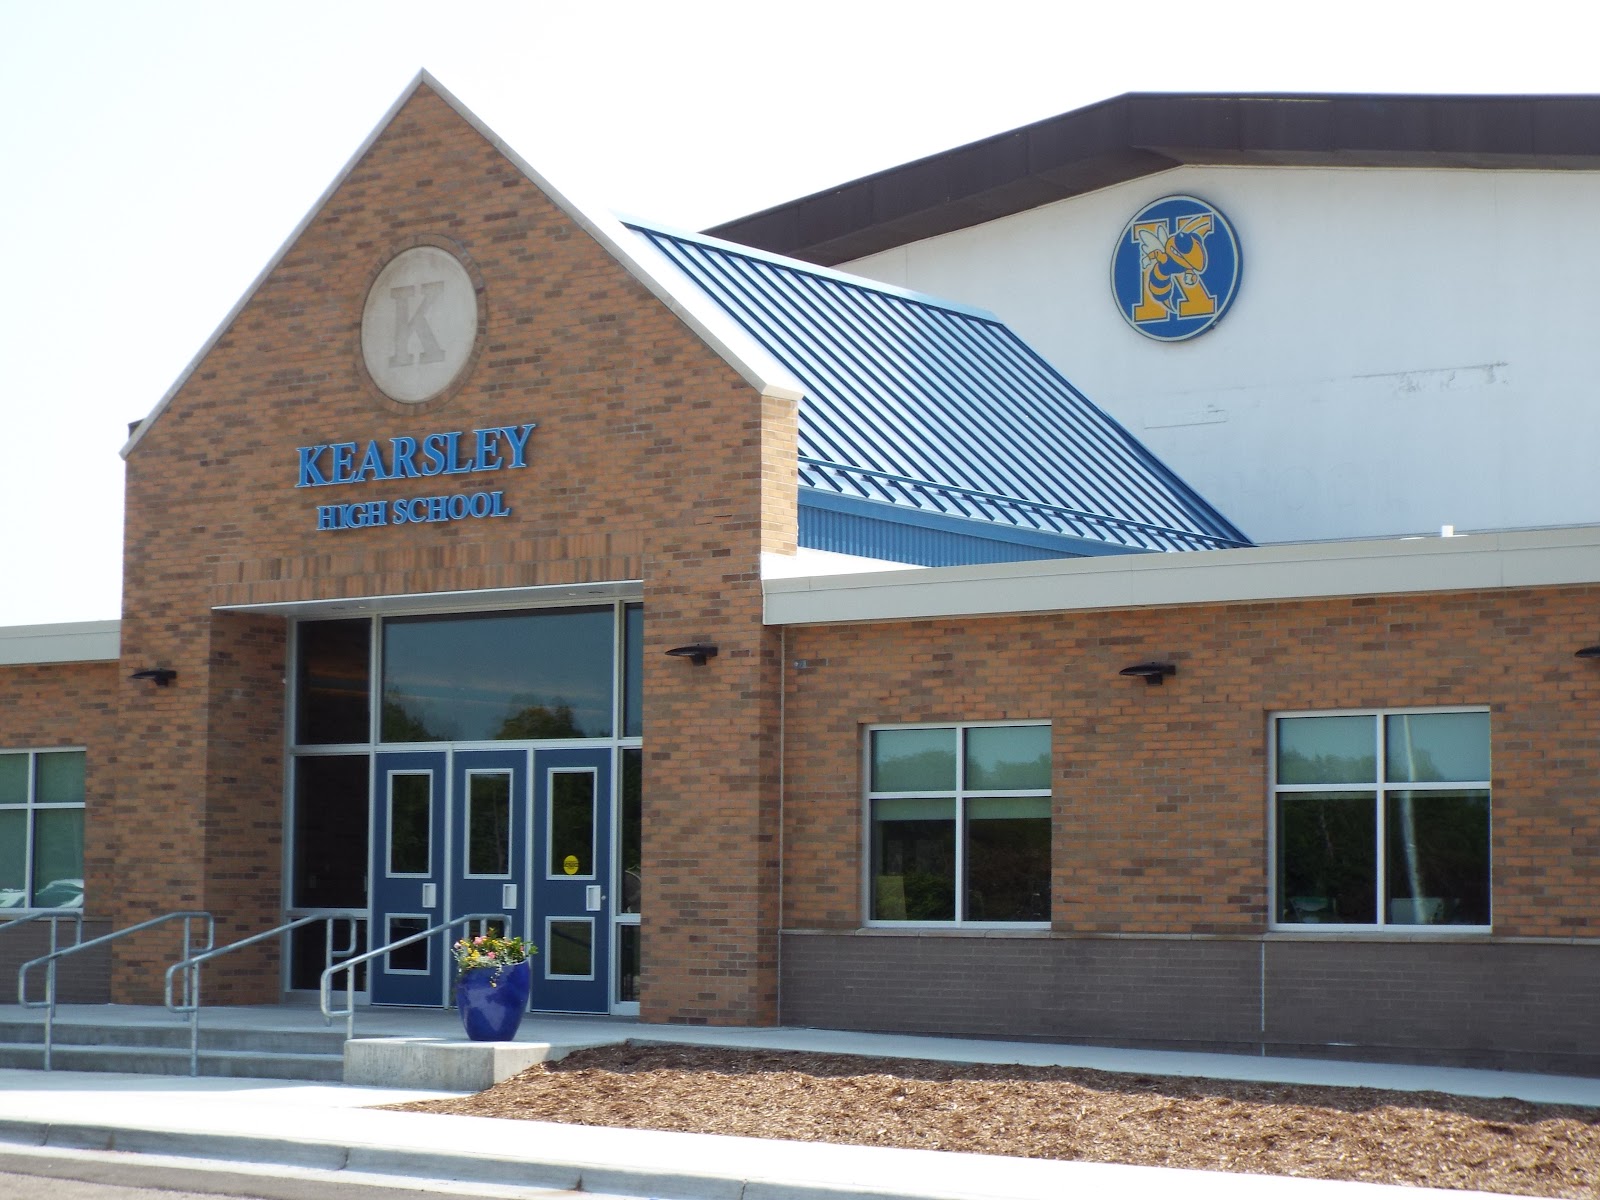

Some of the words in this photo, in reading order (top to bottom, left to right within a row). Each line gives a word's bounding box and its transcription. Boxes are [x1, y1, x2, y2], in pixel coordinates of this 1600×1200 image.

[388, 281, 446, 368] K
[295, 424, 536, 488] KEARSLEY
[316, 501, 388, 531] HIGH
[392, 491, 511, 525] SCHOOL
